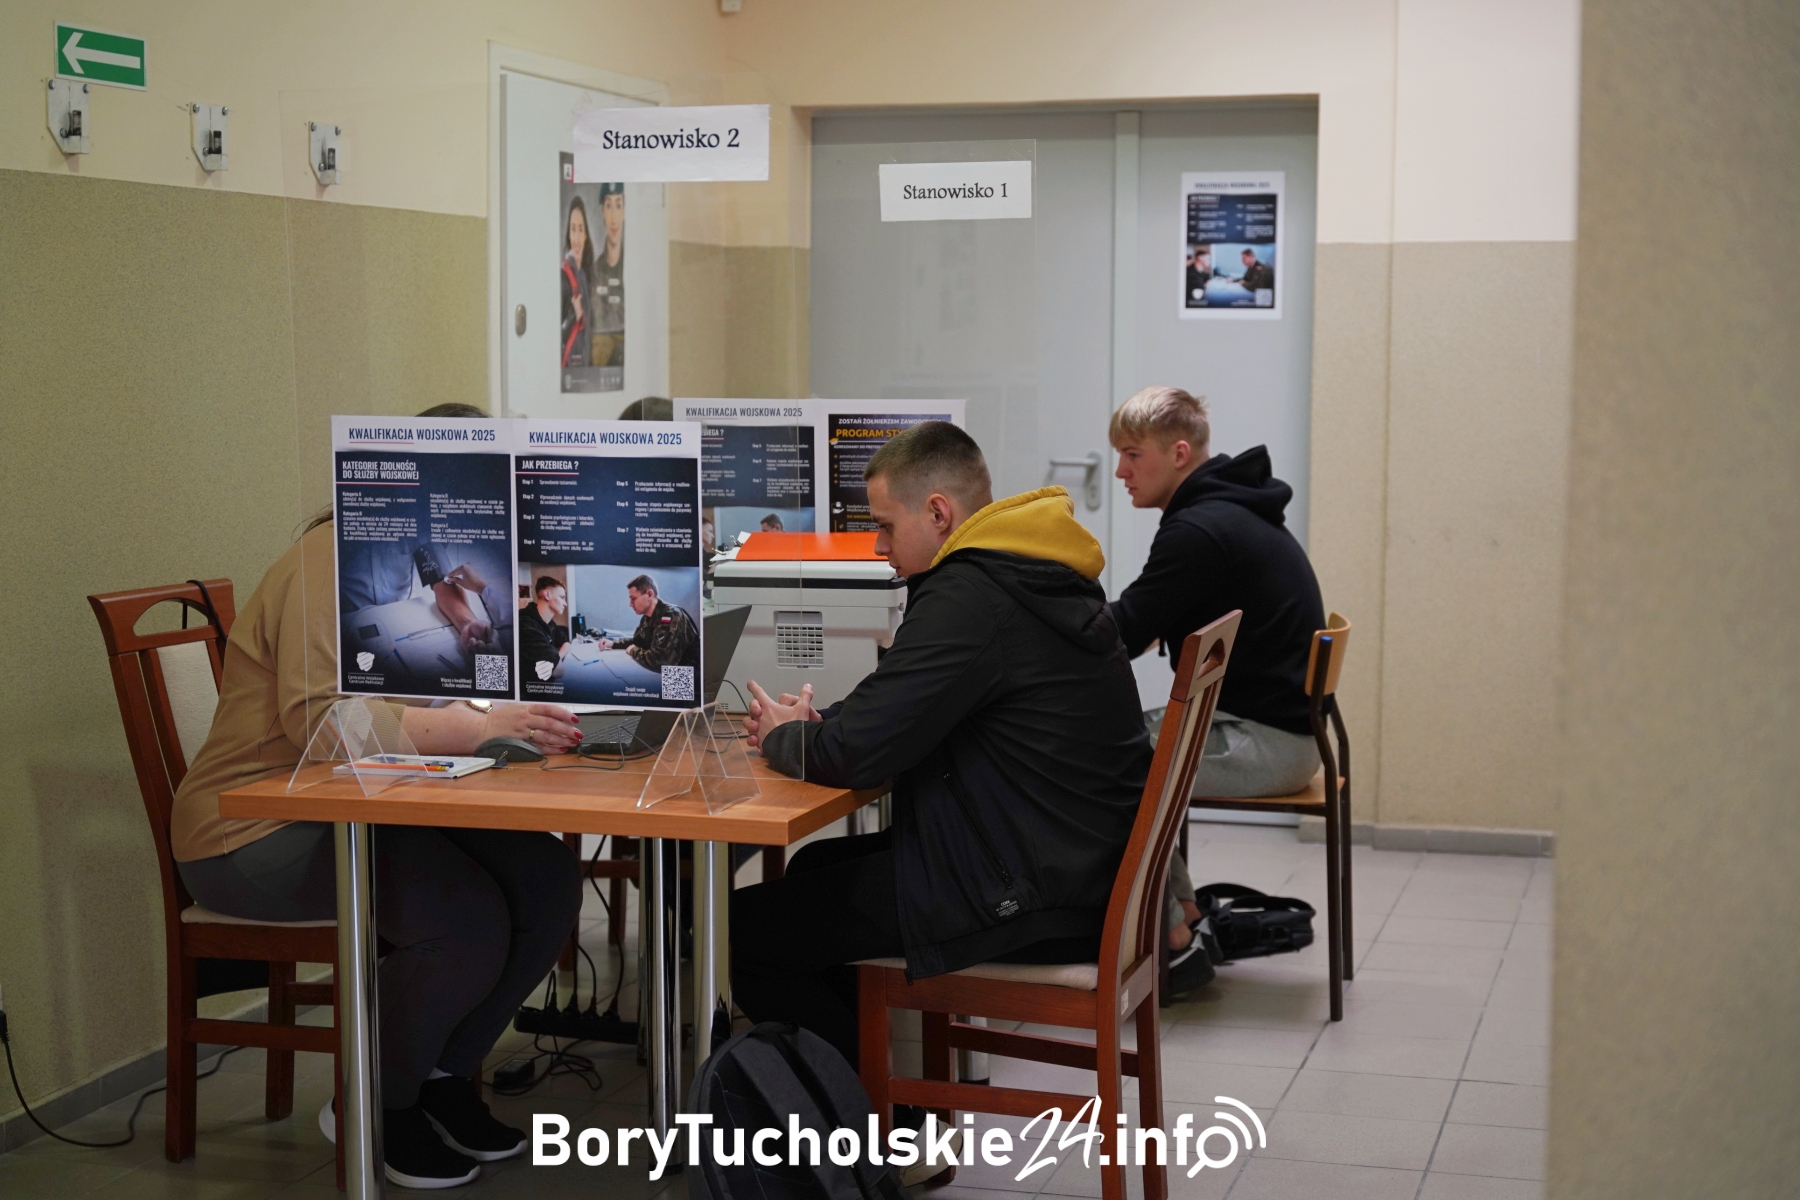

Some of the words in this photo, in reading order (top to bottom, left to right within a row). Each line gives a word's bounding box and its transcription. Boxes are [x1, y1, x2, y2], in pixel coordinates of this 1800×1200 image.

[602, 128, 720, 150] Stanowisko
[727, 128, 740, 148] 2
[903, 183, 994, 200] Stanowisko
[1000, 183, 1008, 199] 1
[686, 407, 737, 416] KWALIFIKACJA
[740, 408, 781, 416] WOJSKOWA
[784, 408, 802, 417] 2025
[349, 428, 414, 440] KWALIFIKACJA
[416, 429, 468, 440] WOJSKOWA
[471, 430, 495, 441] 2025
[529, 432, 596, 444] KWALIFIKACJA
[600, 432, 653, 444] WOJSKOWA
[657, 433, 682, 445] 2025
[343, 461, 378, 470] KATEGORIE
[380, 460, 416, 470] ZDOLNOŚCI
[522, 460, 534, 470] JAK
[536, 460, 572, 470] PRZEBIEGA
[574, 461, 579, 470] ?
[343, 470, 351, 478] DO
[354, 469, 378, 479] SŁUŻBY
[380, 471, 419, 480] WOJSKOWEJ
